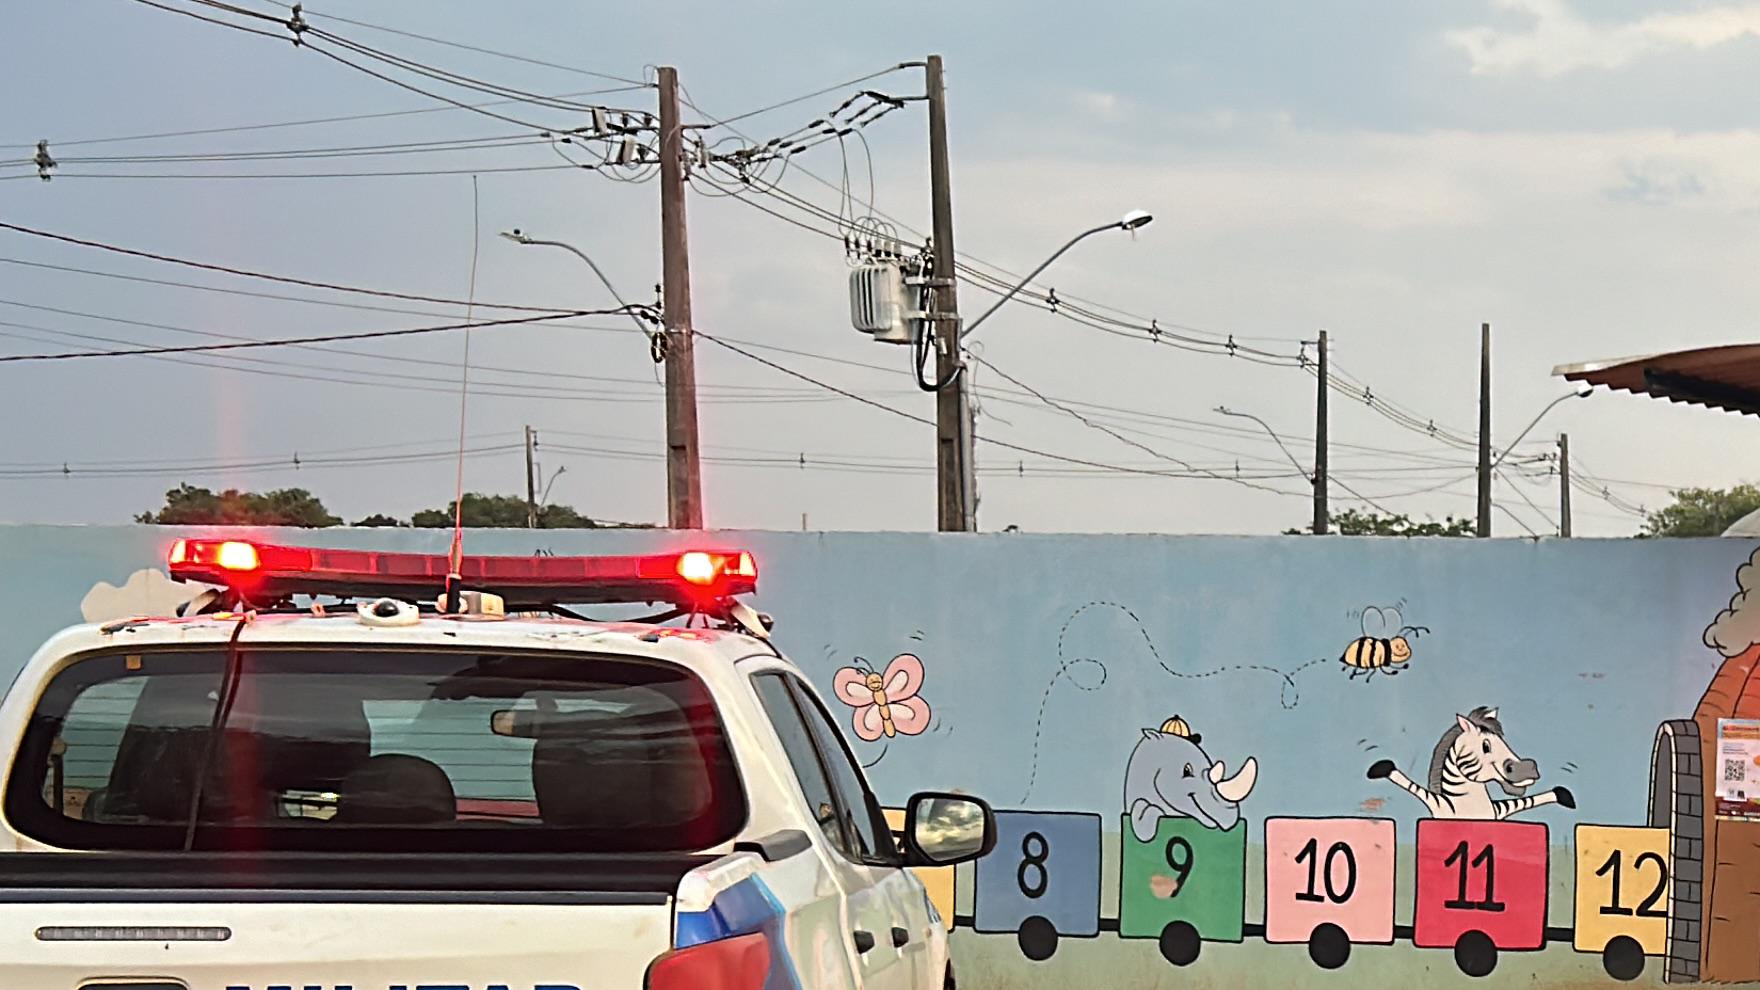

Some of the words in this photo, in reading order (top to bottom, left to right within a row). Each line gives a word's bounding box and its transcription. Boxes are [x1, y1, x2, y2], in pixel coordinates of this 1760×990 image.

[1016, 831, 1050, 899] 8
[1165, 836, 1194, 898] 9
[1294, 838, 1358, 904] 10
[1443, 840, 1506, 912] 11
[1595, 849, 1668, 917] 12
